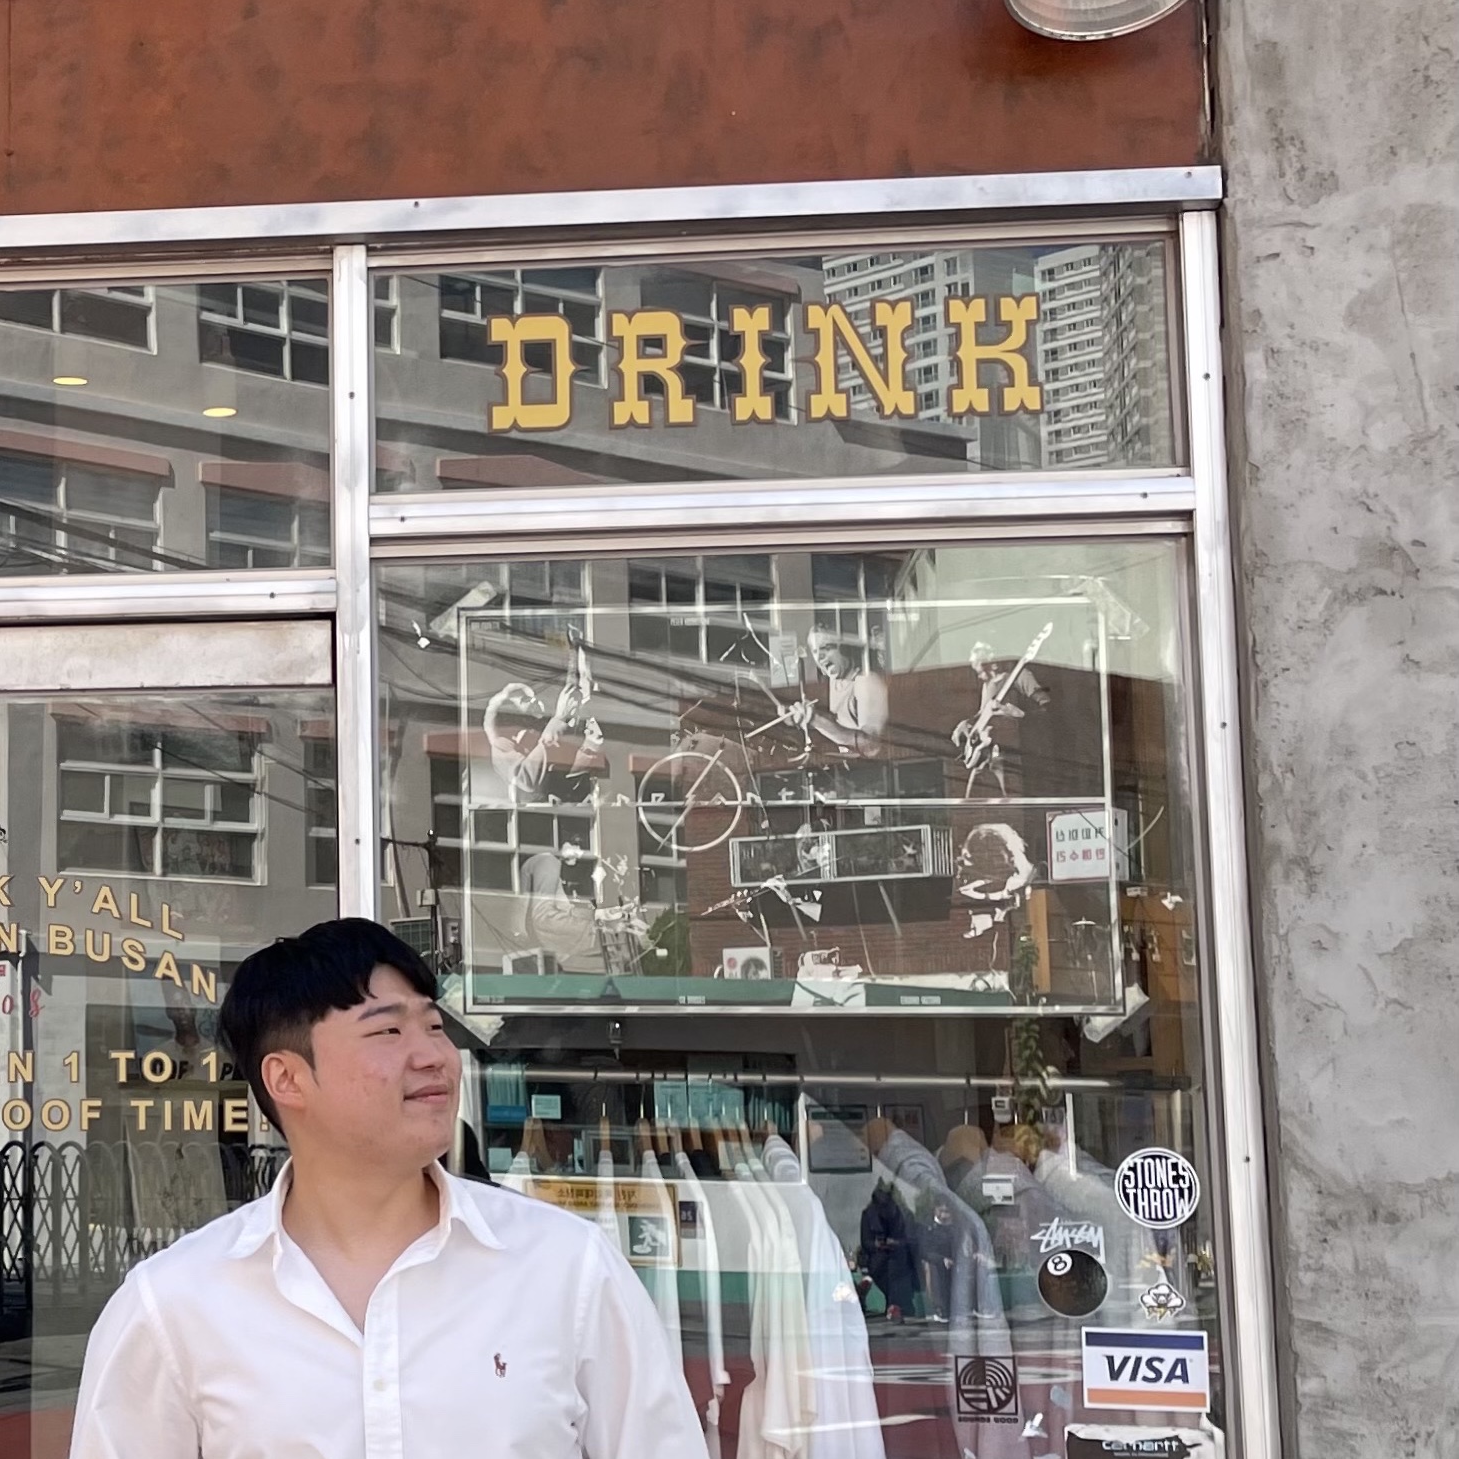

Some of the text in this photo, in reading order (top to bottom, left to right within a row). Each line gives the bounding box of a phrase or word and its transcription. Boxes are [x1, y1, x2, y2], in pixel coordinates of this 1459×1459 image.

[487, 293, 1044, 434] DRINK
[37, 875, 185, 941] Y'ALL
[47, 923, 218, 1005] BUSAN
[62, 1050, 81, 1083] 1
[109, 1049, 174, 1084] TO
[1124, 1157, 1191, 1190] STONES
[1125, 1188, 1191, 1220] THROW
[1105, 1354, 1190, 1385] VISA
